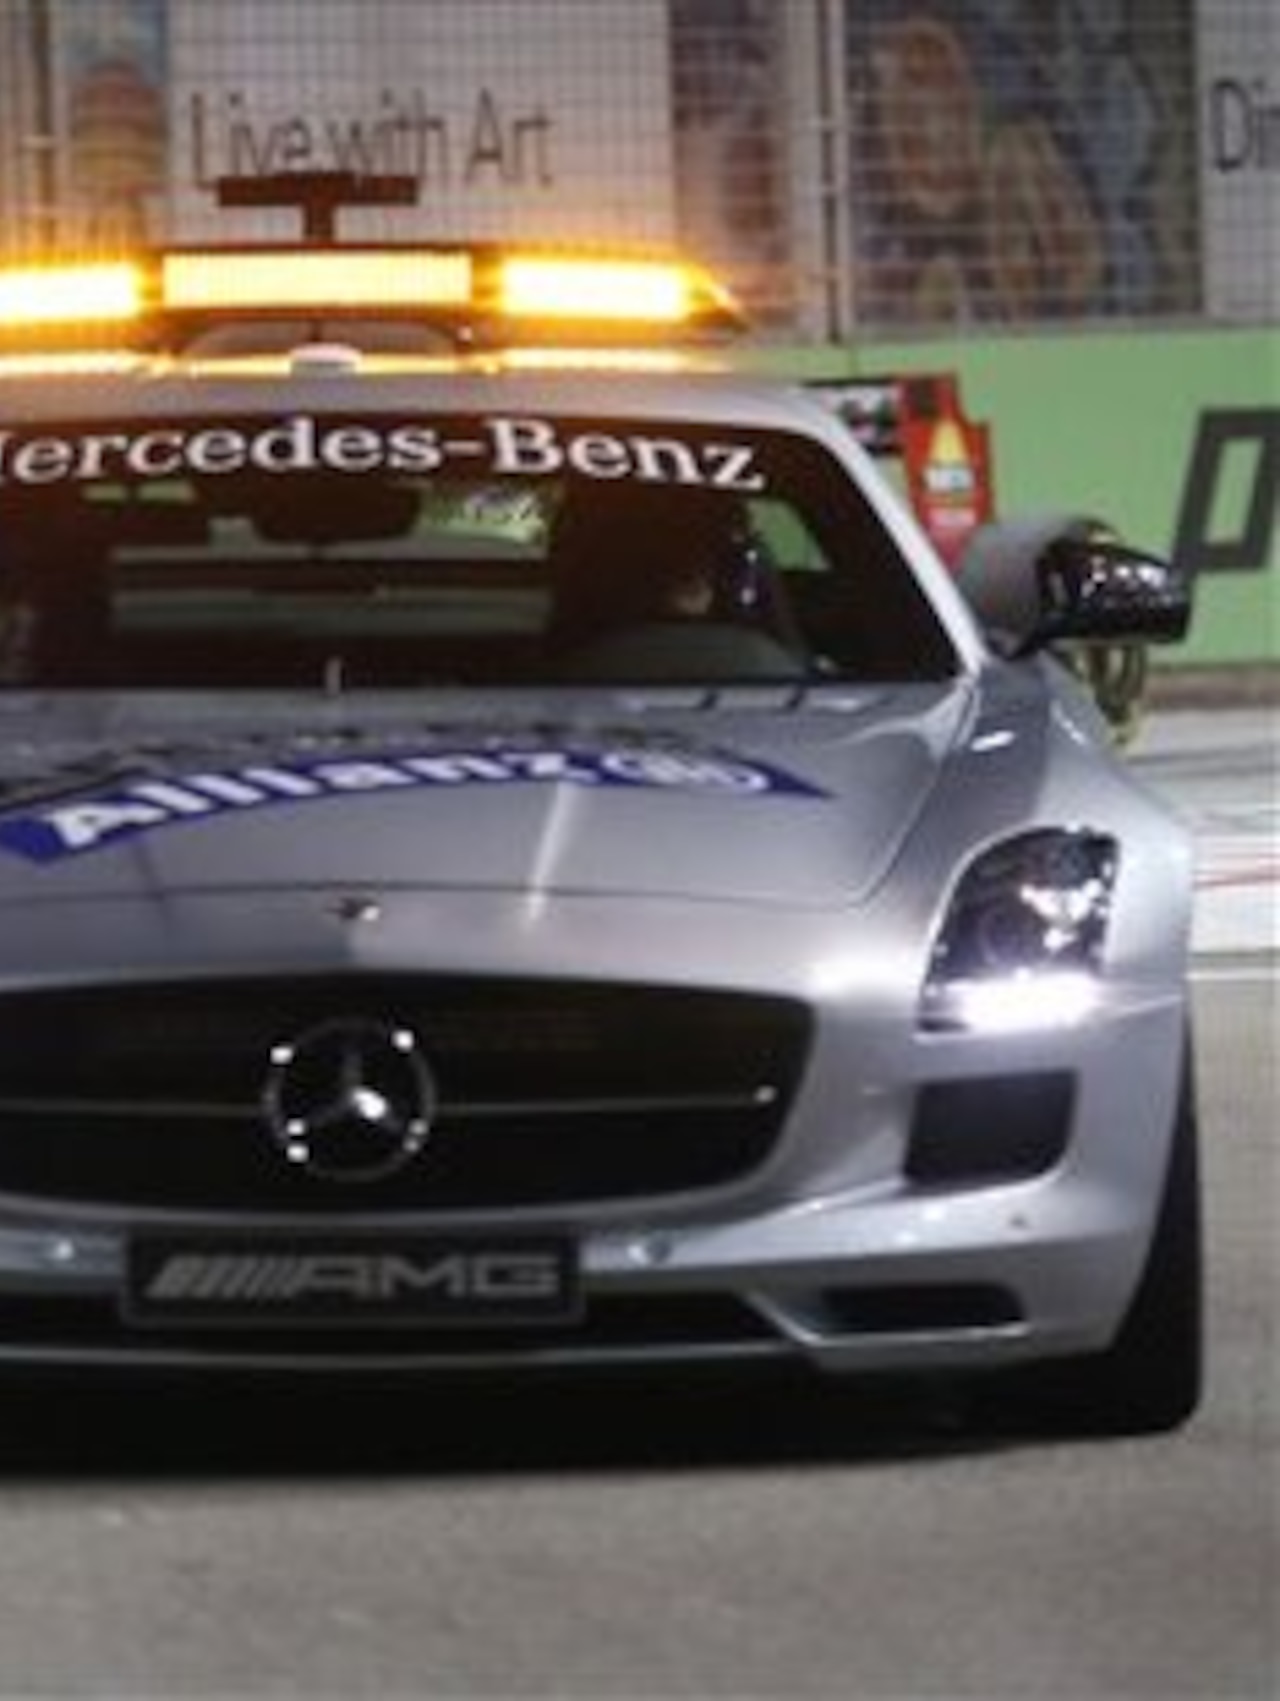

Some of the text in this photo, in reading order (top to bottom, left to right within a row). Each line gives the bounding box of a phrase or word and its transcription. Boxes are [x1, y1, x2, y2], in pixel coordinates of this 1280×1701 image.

[190, 88, 554, 190] Live with Art
[1210, 77, 1280, 174] Di
[42, 750, 600, 848] Allianz
[285, 1252, 561, 1298] AMG
